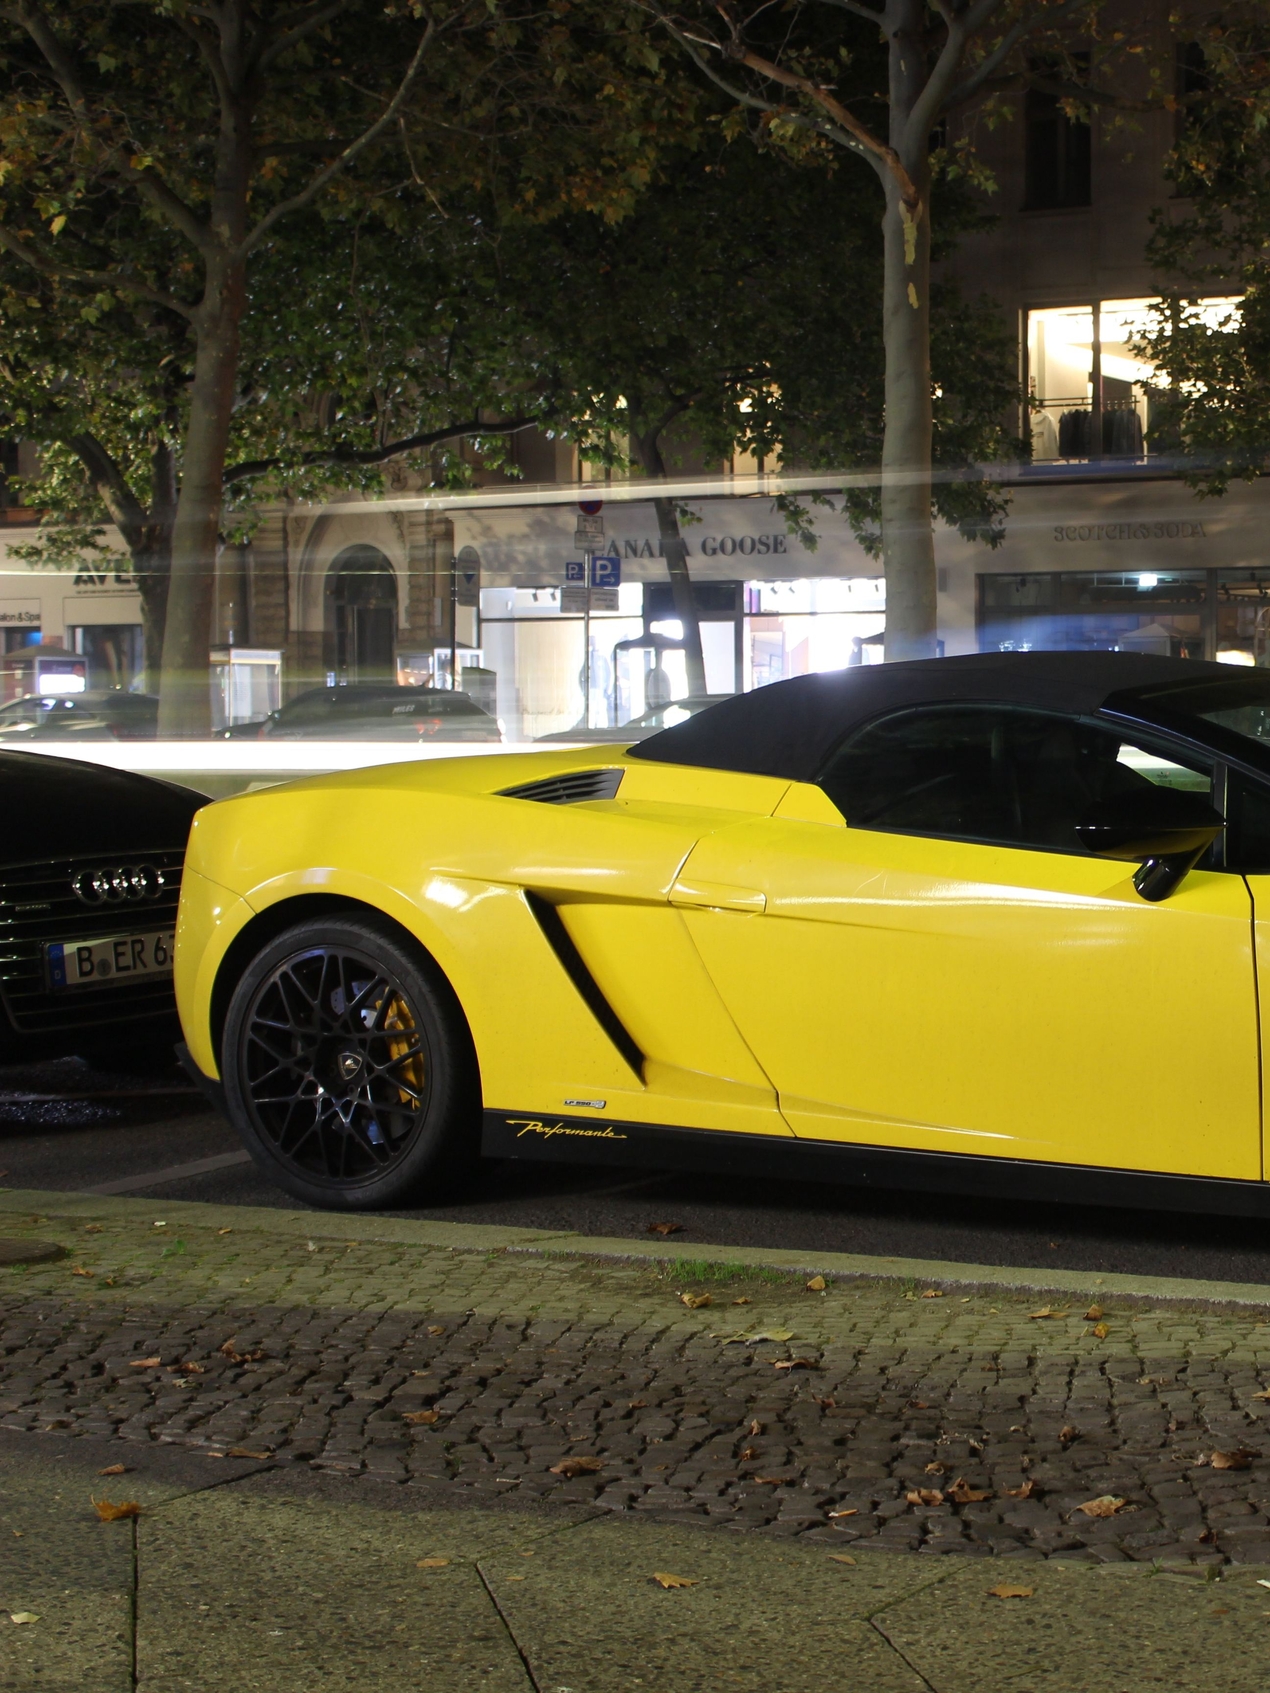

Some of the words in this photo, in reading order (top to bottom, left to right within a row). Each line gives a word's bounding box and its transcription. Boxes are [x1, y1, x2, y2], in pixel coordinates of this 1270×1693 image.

[1053, 525, 1131, 542] SCOTCH
[1153, 521, 1207, 539] SODA
[602, 536, 692, 560] ANAA
[701, 534, 787, 557] GOOSE
[568, 564, 579, 579] P
[595, 560, 612, 584] P
[24, 612, 41, 624] Spa
[75, 945, 96, 978] B
[113, 938, 148, 973] ER
[506, 1120, 627, 1139] Performante
